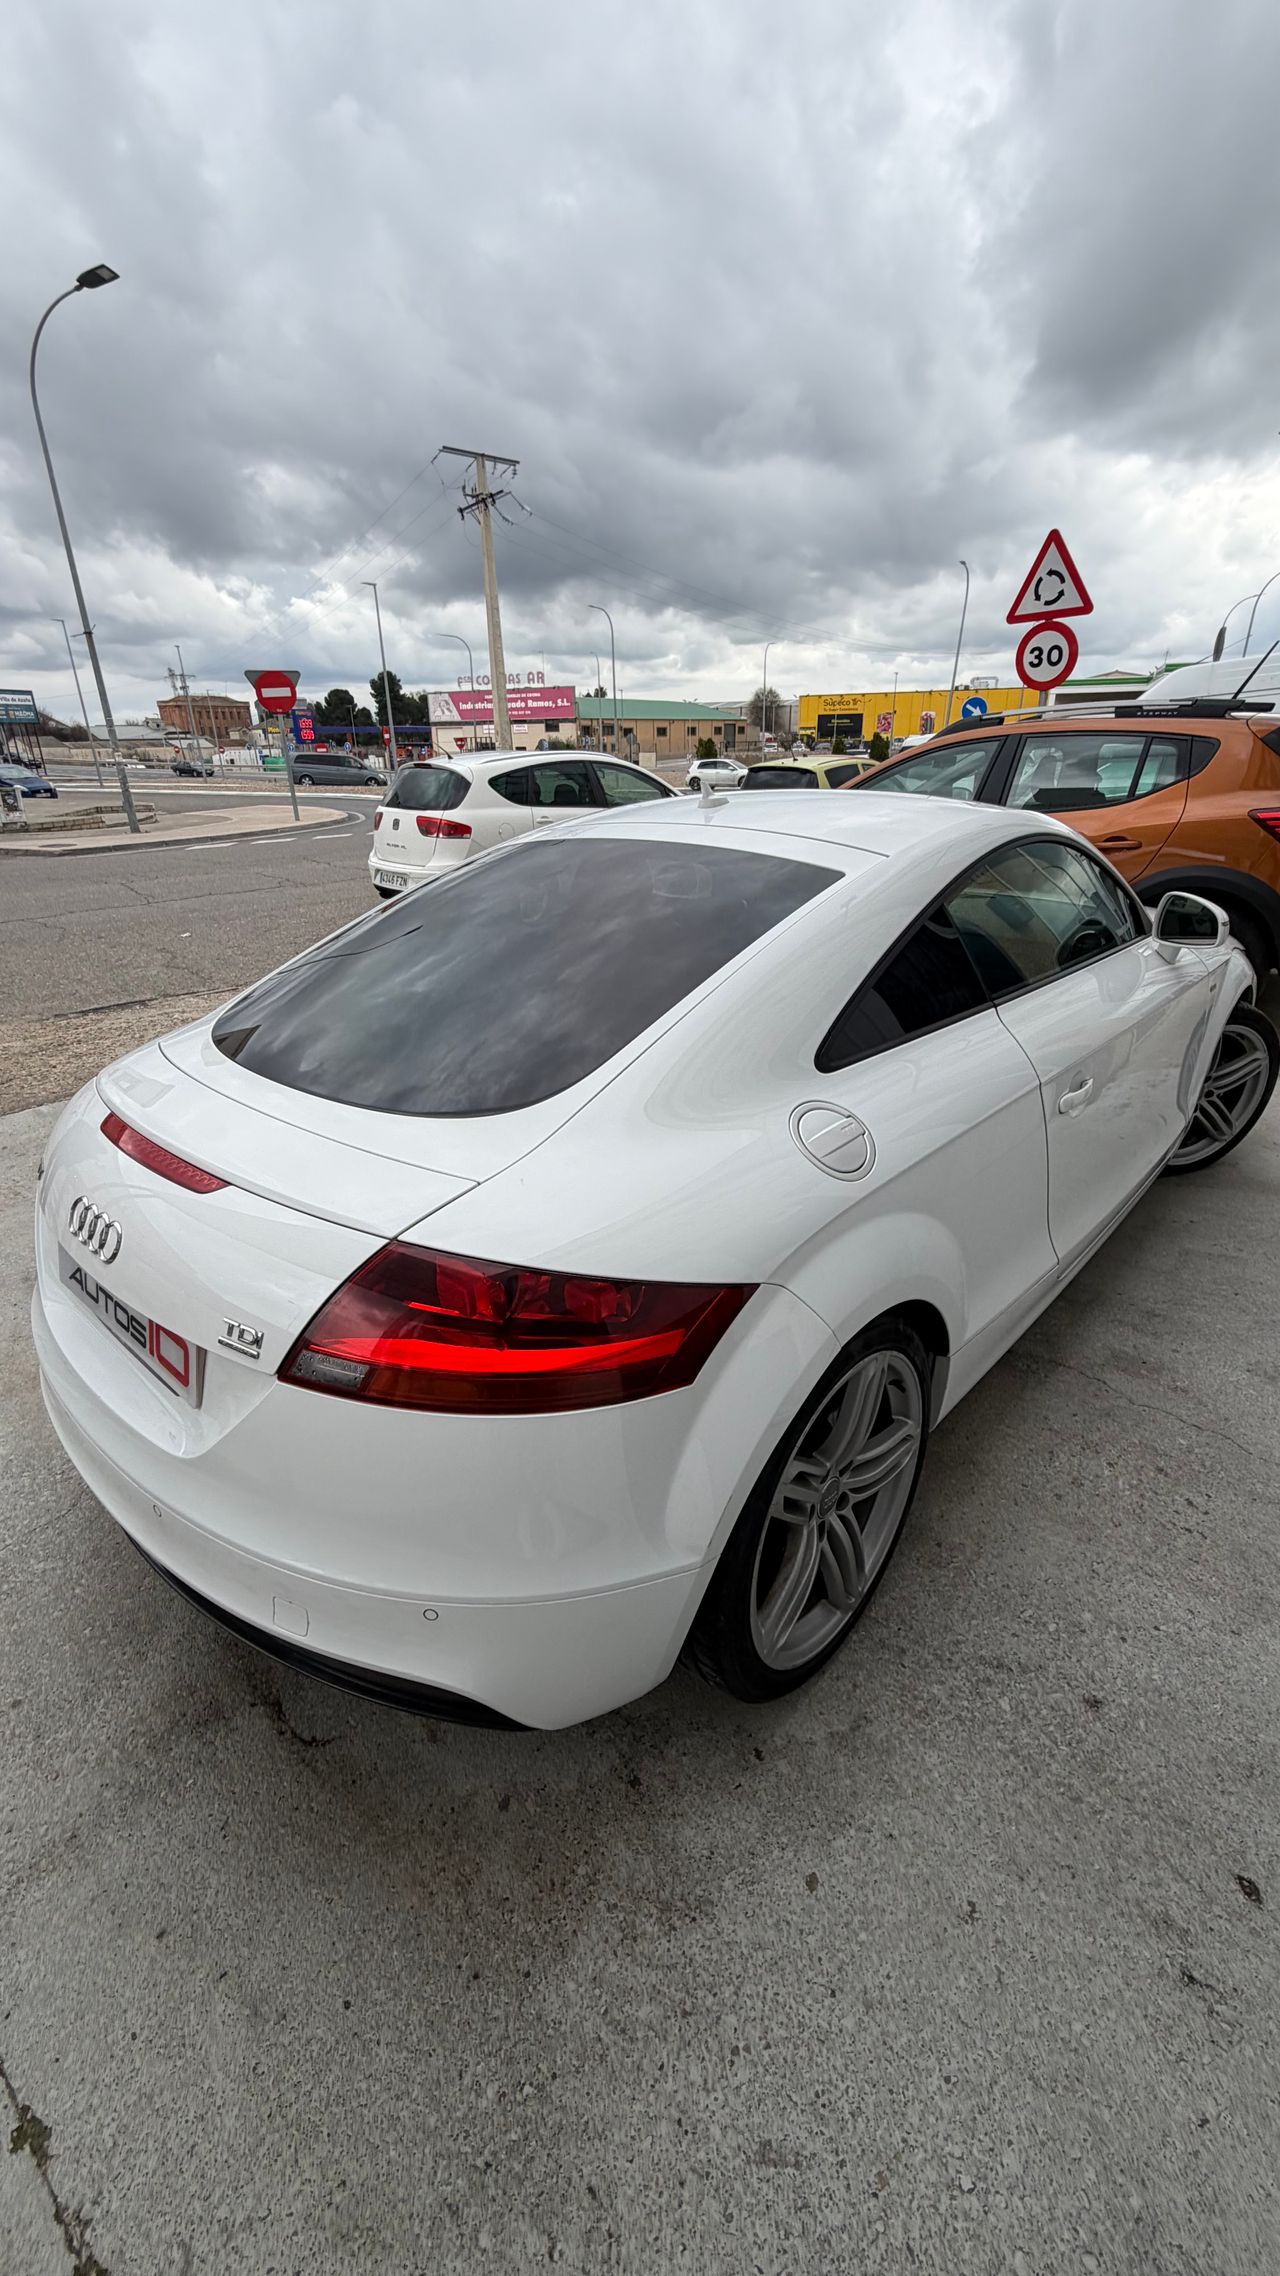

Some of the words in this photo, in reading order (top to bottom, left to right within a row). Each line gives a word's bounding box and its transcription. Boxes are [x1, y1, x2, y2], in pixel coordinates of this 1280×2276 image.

[1028, 644, 1064, 668] 30
[476, 673, 521, 685] COAS
[527, 699, 556, 709] Ramos,
[557, 698, 571, 707] S.L.
[396, 875, 408, 887] FZN
[223, 1316, 265, 1350] TDI
